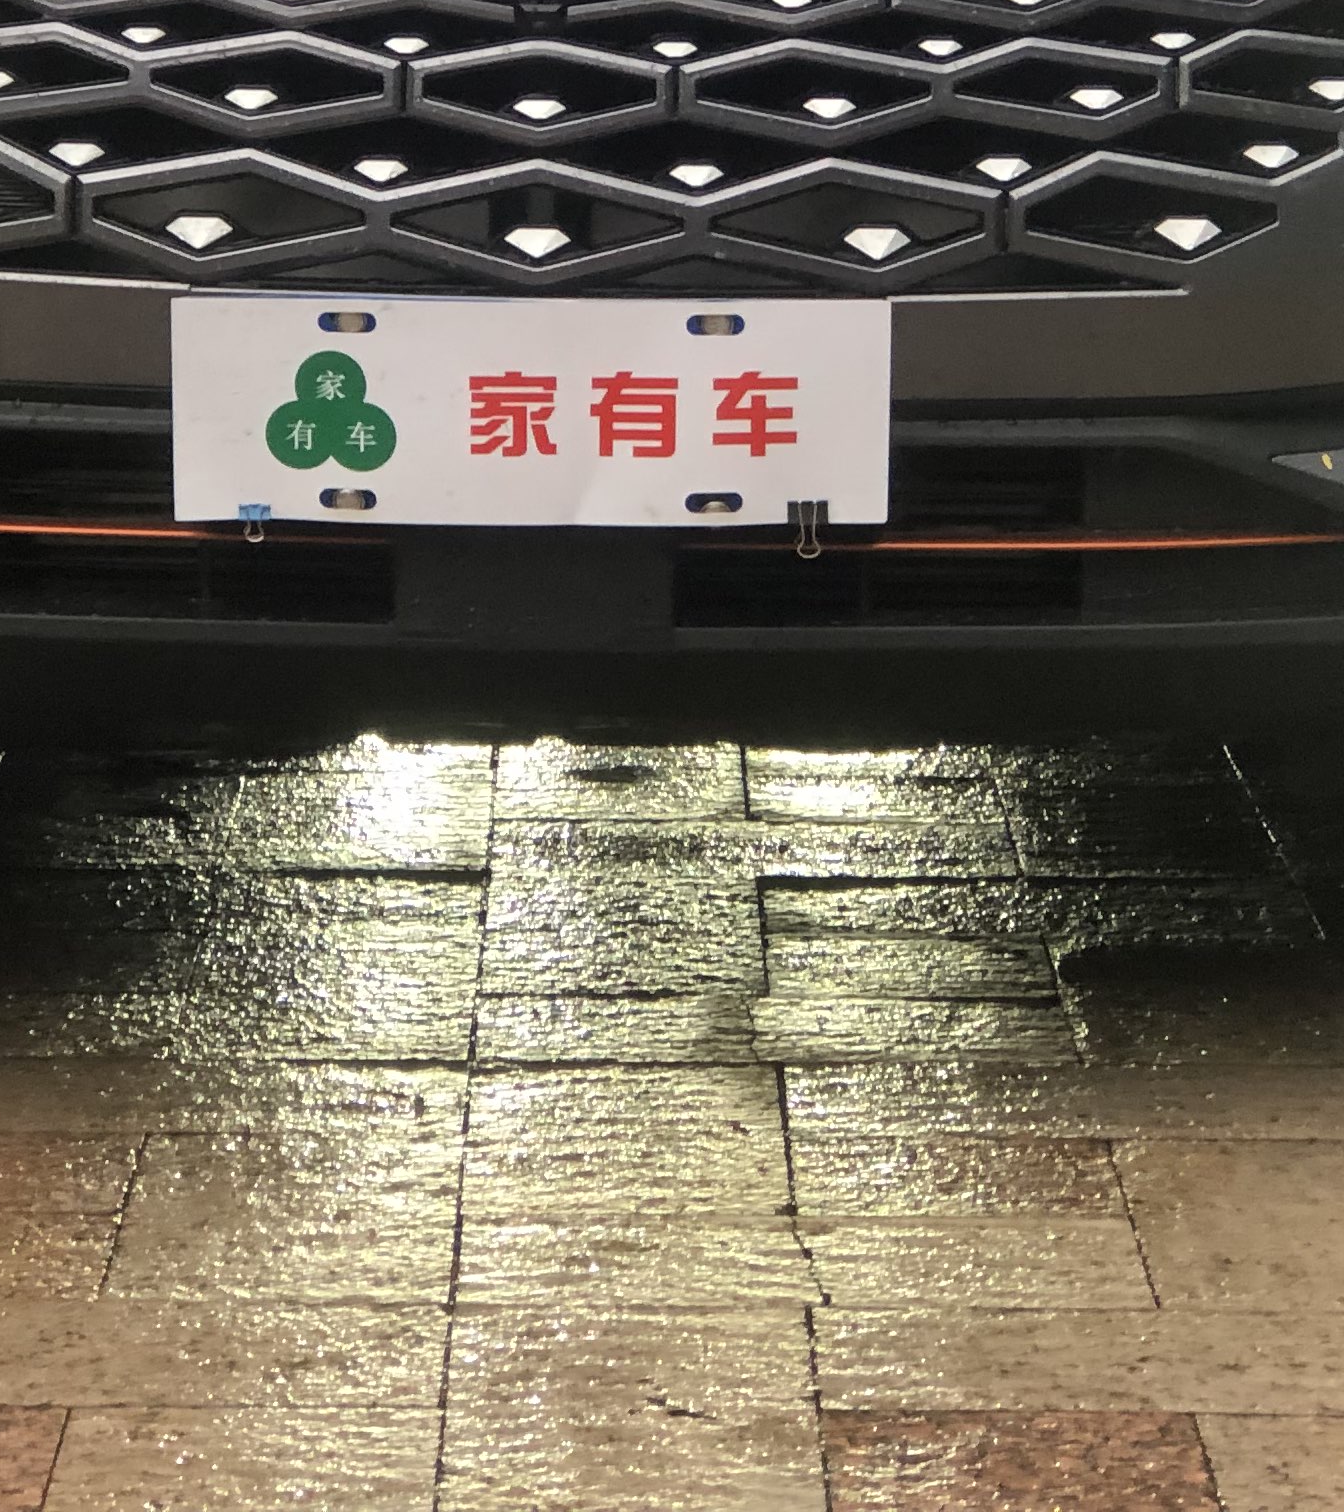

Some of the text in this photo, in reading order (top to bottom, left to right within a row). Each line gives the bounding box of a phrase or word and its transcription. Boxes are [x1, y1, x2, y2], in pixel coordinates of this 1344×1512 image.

[316, 369, 346, 401] 家
[468, 370, 798, 458] 家有车
[285, 419, 377, 453] 有 车
